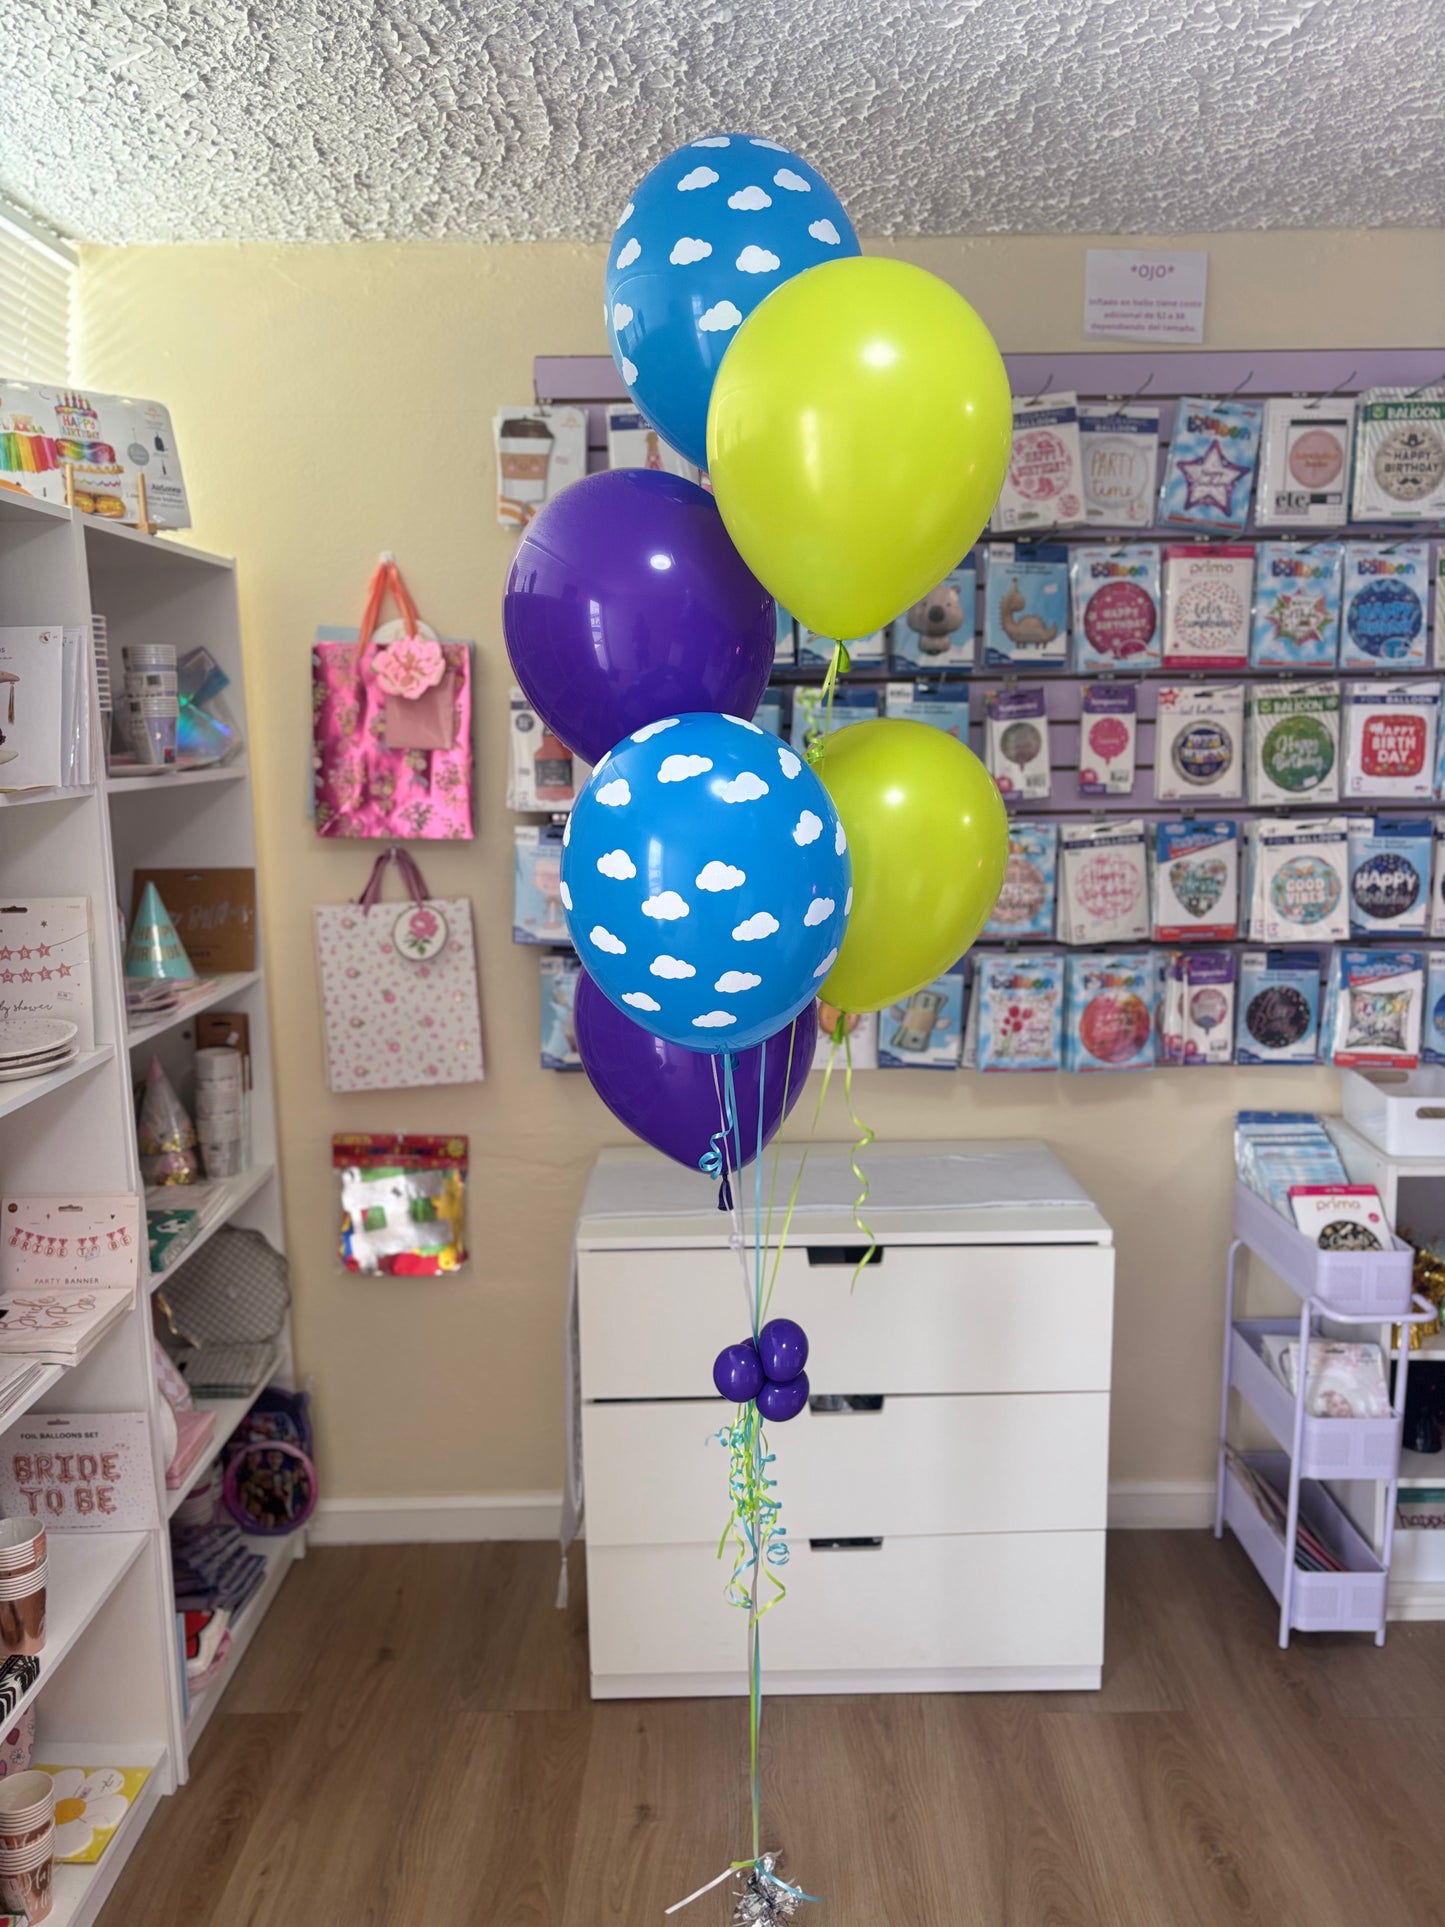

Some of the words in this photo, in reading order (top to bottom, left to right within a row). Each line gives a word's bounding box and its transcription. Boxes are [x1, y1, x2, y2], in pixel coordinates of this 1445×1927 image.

[1387, 405, 1441, 419] BALLOON
[1393, 451, 1432, 461] HAPPY
[1091, 450, 1136, 478] PARTY
[1384, 463, 1440, 473] BIRTHDAY
[1102, 607, 1140, 618] HAPPY
[1357, 601, 1416, 622] HAPPY
[1096, 618, 1148, 631] BIRTHDAY
[1274, 698, 1323, 713] BALLOON
[1385, 696, 1433, 704] BALLOON
[1370, 722, 1416, 735] HAPPY
[1371, 736, 1416, 750] BIRTH
[1377, 750, 1410, 764] DAY
[1293, 833, 1342, 844] BALLOON
[1285, 878, 1326, 891] GOOD
[1354, 870, 1417, 892] HAPPY
[1287, 891, 1326, 904] VIBES
[990, 973, 1054, 990] balloon
[13, 1000, 53, 1012] shower
[9, 1236, 66, 1257] BRIDE
[110, 1236, 130, 1250] BE
[65, 1277, 100, 1285] BANNER
[40, 1432, 82, 1440] BALLOONS
[84, 1431, 99, 1439] SET
[13, 1451, 121, 1484] BRIDE
[19, 1487, 65, 1516] TO
[74, 1485, 118, 1516] BE
